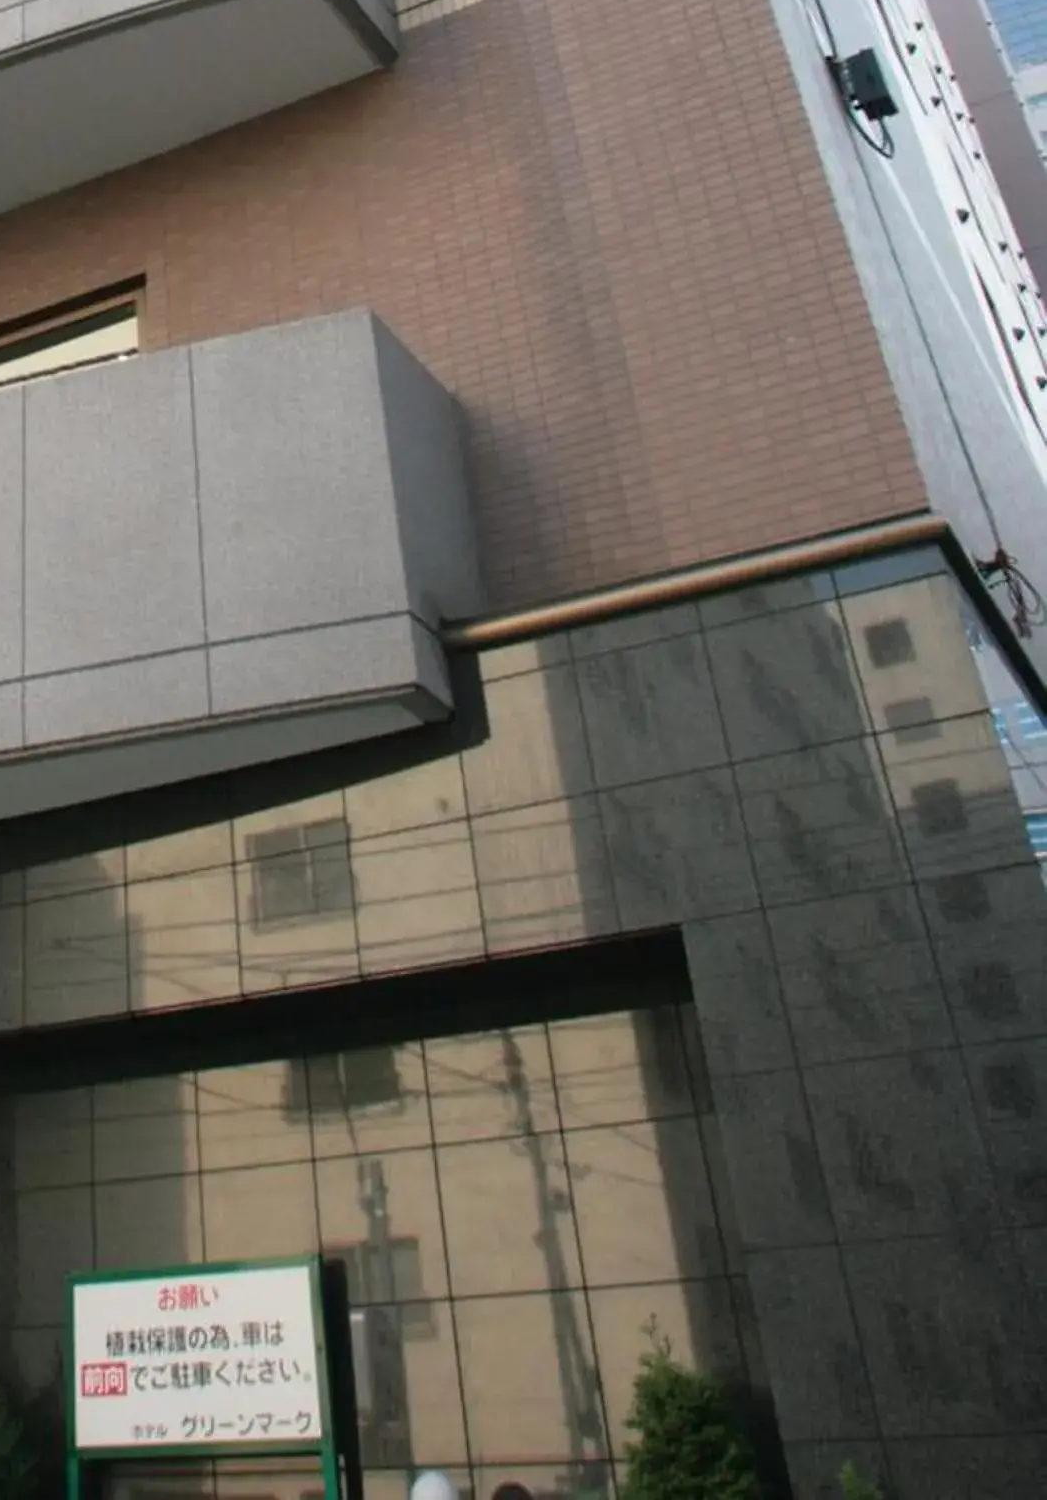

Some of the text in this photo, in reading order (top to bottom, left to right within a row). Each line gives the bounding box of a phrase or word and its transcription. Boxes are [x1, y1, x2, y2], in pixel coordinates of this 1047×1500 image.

[157, 1283, 220, 1312] お願い
[131, 1411, 313, 1440] ホテル グリーンマーク
